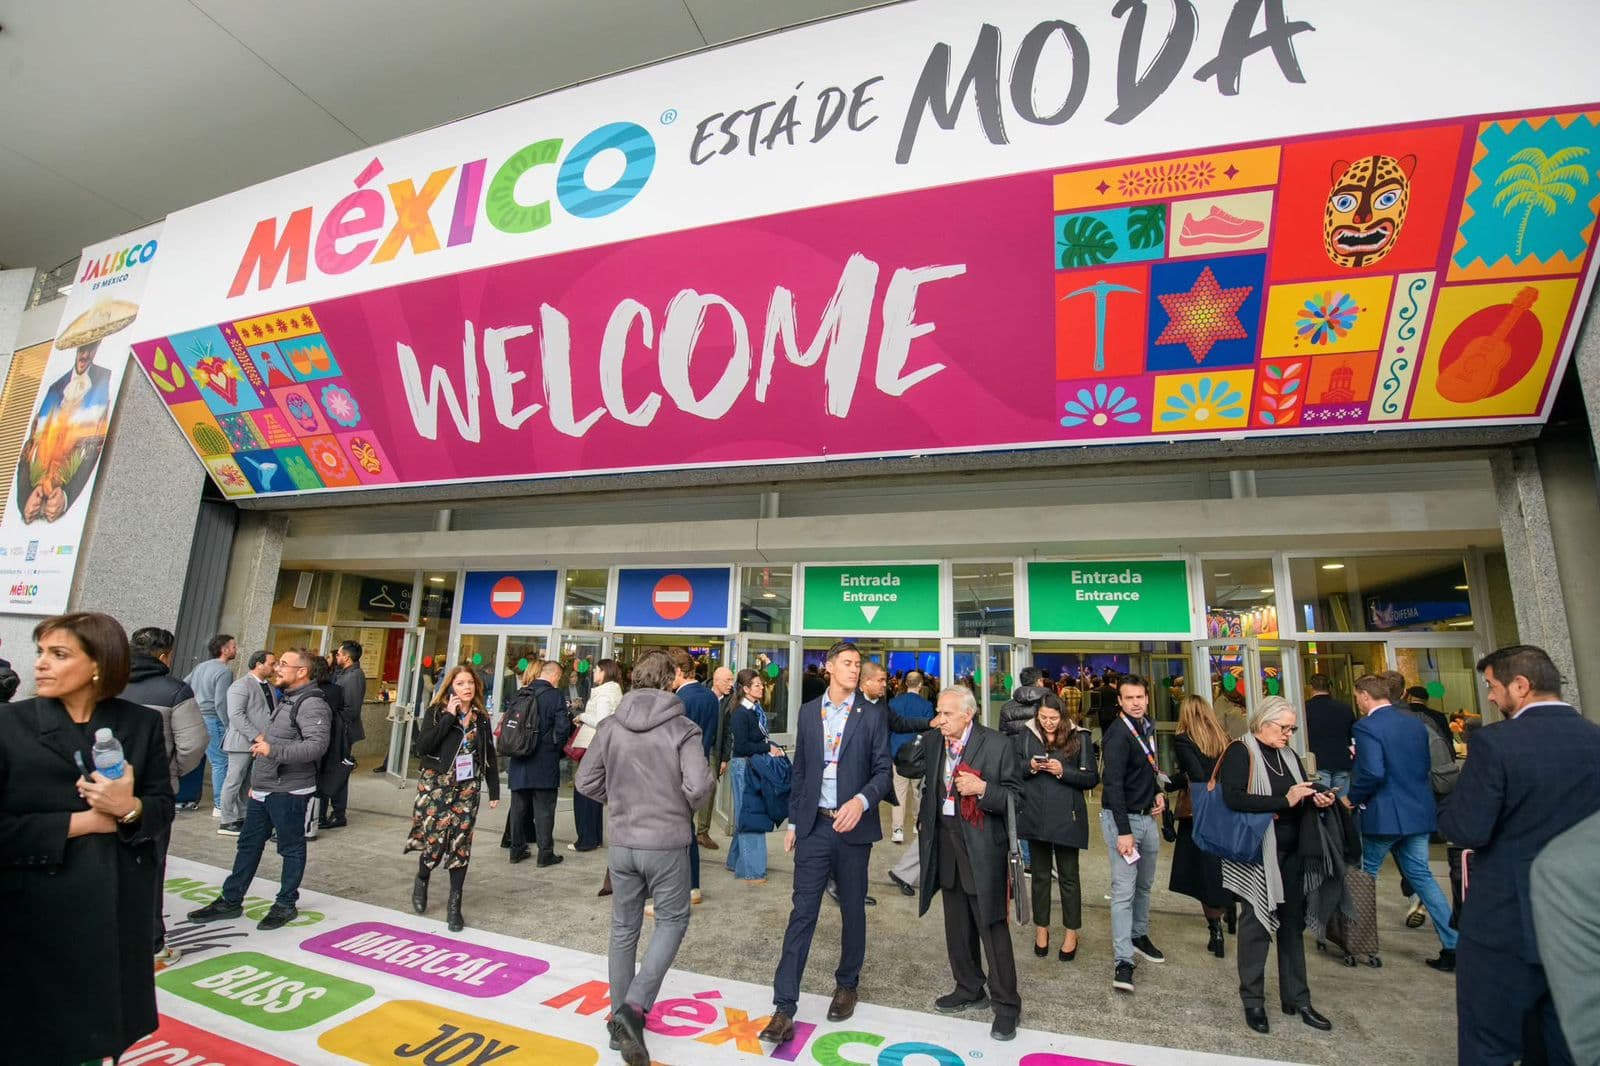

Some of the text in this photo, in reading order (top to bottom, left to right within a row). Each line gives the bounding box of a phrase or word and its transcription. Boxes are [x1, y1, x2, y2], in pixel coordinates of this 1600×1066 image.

[689, 81, 805, 166] ESTÁ
[809, 76, 885, 144] DE
[895, 0, 1317, 165] MODA
[80, 239, 158, 284] JALISCO
[92, 282, 101, 290] ES
[396, 251, 967, 443] WELCOME
[840, 573, 901, 587] Entrada
[842, 592, 898, 603] Entrance
[1071, 570, 1143, 585] Entrada
[1075, 589, 1140, 601] Entrance
[331, 931, 508, 986] MAGICAL
[191, 965, 328, 1014] BLISS
[394, 1023, 519, 1066] JOY
